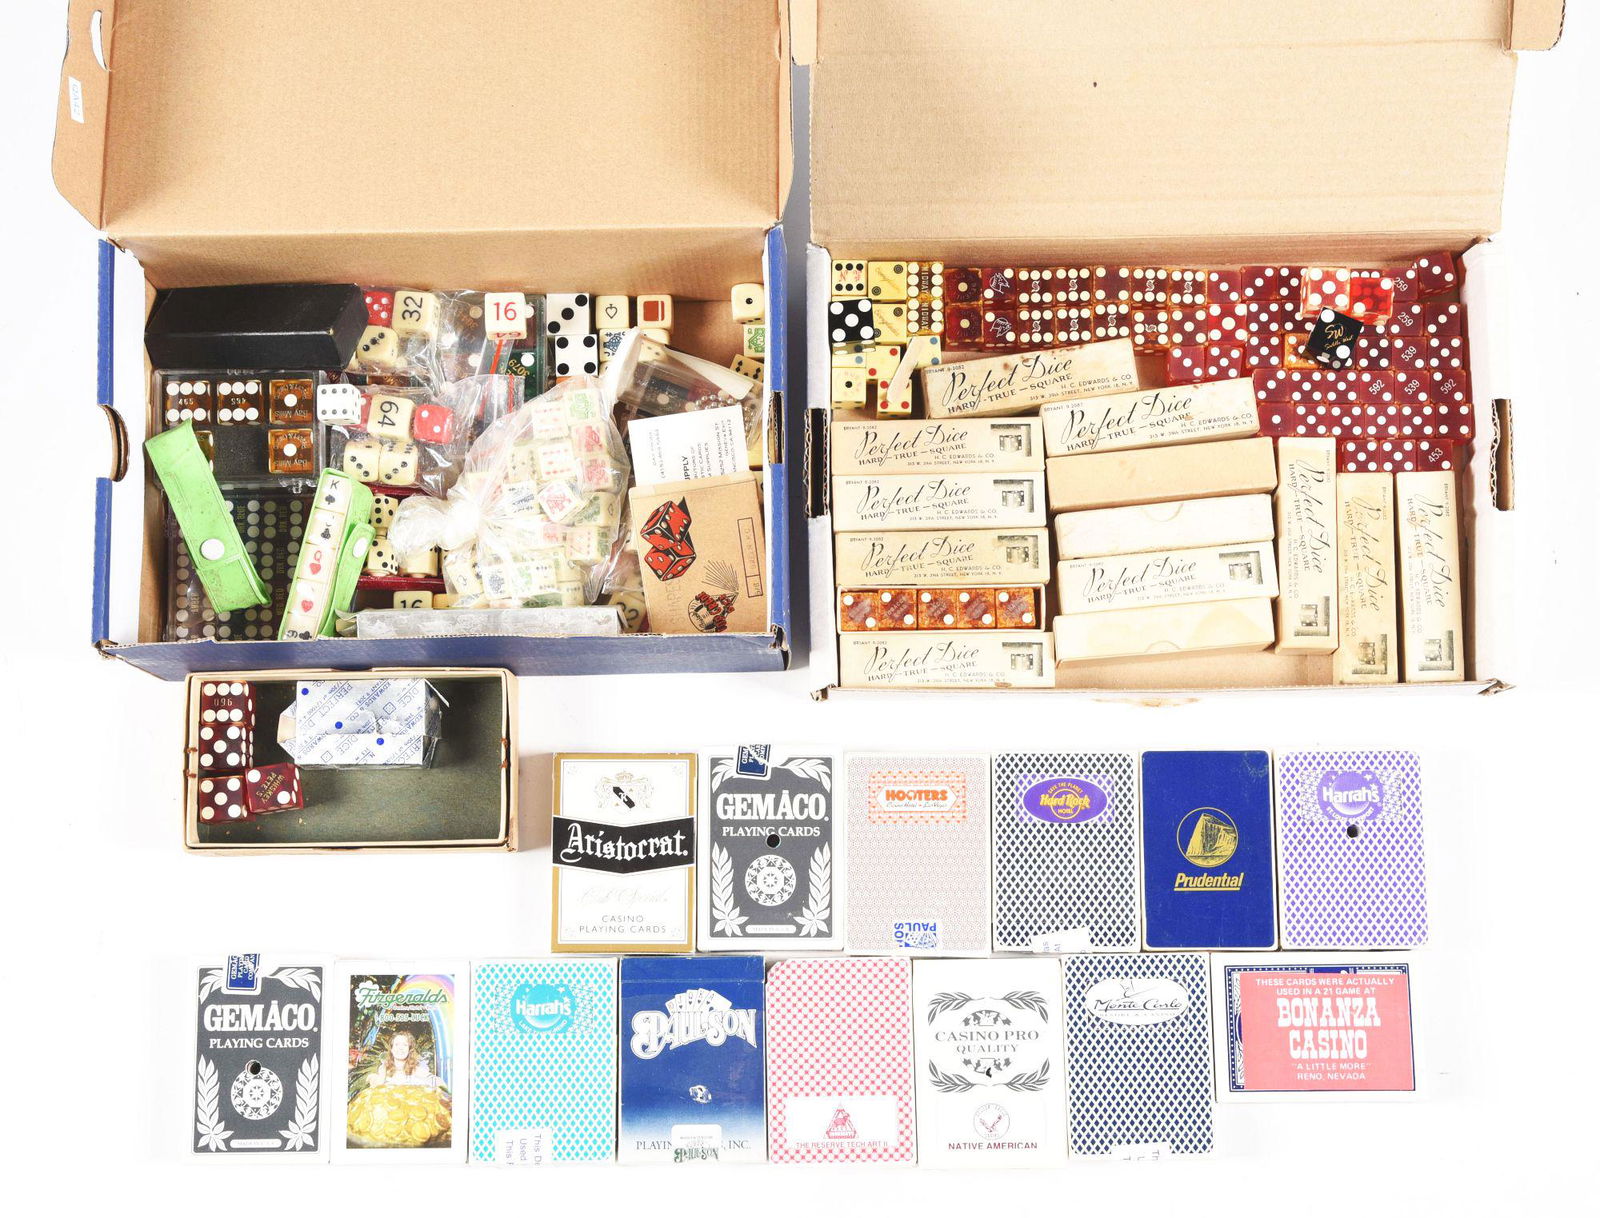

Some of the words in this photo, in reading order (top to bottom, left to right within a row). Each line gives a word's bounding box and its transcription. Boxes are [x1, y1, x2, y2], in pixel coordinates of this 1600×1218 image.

[402, 296, 424, 323] 32
[493, 301, 517, 321] 16
[921, 302, 929, 332] MIDWAY
[1397, 311, 1414, 327] 259
[1401, 345, 1417, 362] 539
[942, 357, 1019, 411] Perfect
[1022, 352, 1072, 381] Dice
[1368, 379, 1385, 396] 592
[1404, 379, 1421, 396] 539
[1440, 378, 1457, 394] 592
[377, 400, 399, 428] 64
[1060, 399, 1139, 449] Perfect
[1142, 391, 1193, 420] Dice
[855, 429, 923, 466] Perfect
[926, 424, 967, 444] Dice
[1428, 448, 1444, 464] 453
[857, 484, 926, 521] Perfect
[928, 479, 970, 499] Dice
[861, 541, 930, 578] Perfect
[933, 535, 974, 555] Dice
[1310, 532, 1331, 573] Dice
[1083, 563, 1151, 603] Perfect
[1154, 556, 1196, 576] Dice
[1431, 566, 1452, 607] Dice
[1366, 569, 1387, 611] Dice
[864, 646, 934, 682] Perfect
[937, 641, 979, 661] Dice
[261, 774, 287, 804] WHISKEY
[885, 790, 948, 801] HOOTERS
[1040, 794, 1065, 806] Hard
[1065, 793, 1091, 809] Rock
[722, 827, 774, 837] PLAYING
[776, 826, 820, 837] CARDS
[1175, 872, 1244, 888] Prudential
[602, 915, 644, 923] CASINO
[1256, 978, 1285, 986] THESE
[1286, 977, 1317, 986] CARDS
[1319, 977, 1344, 986] WERE
[1346, 977, 1395, 986] ACTUALLY
[359, 987, 448, 1007] Fitzgeralds
[1276, 988, 1300, 996] USED
[1302, 988, 1312, 996] IN
[1314, 988, 1322, 996] A
[1323, 987, 1333, 995] 21
[1335, 987, 1361, 996] GAME
[1363, 987, 1376, 995] AT
[1094, 999, 1140, 1012] Monte
[1143, 998, 1182, 1010] Carlo
[1277, 998, 1382, 1028] BONANZA
[209, 1038, 263, 1048] PLAYING
[266, 1038, 310, 1048] CARDS
[935, 1031, 999, 1042] CASINO
[1004, 1030, 1040, 1040] PRO
[956, 1044, 1020, 1054] QUALITY
[1289, 1030, 1368, 1060] CASINO
[1327, 1072, 1366, 1080] NEVADA
[728, 1140, 751, 1149] INC.
[948, 1142, 983, 1150] NATIVE
[986, 1142, 1037, 1150] AMERICAN
